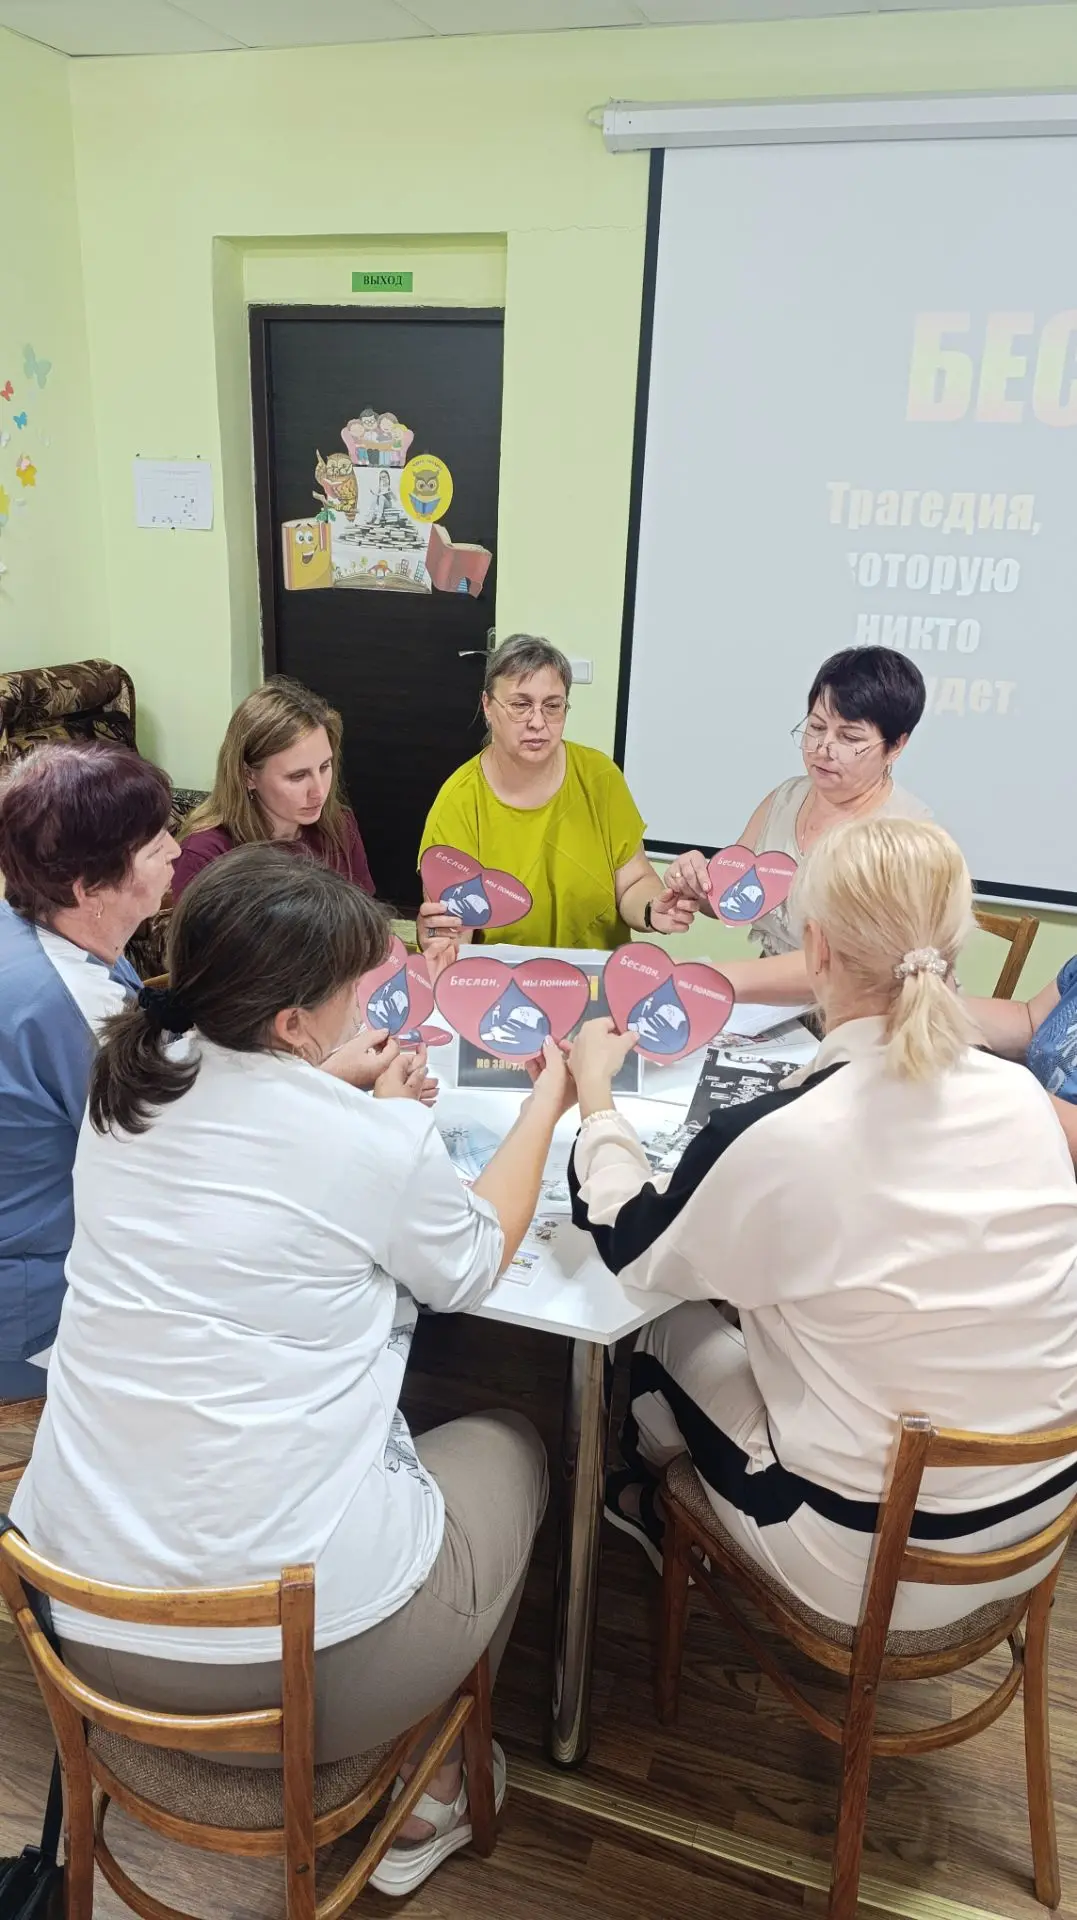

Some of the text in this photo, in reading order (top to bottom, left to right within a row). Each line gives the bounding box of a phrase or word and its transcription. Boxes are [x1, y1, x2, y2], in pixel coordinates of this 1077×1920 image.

[363, 275, 403, 287] ВЫХОД
[905, 309, 1077, 427] БЕС
[826, 481, 1042, 535] Трагедия,
[855, 614, 981, 653] никто
[435, 851, 471, 875] Беслан,
[620, 955, 660, 980] Беслан,
[450, 975, 500, 988] Беслан,
[522, 979, 538, 987] мы
